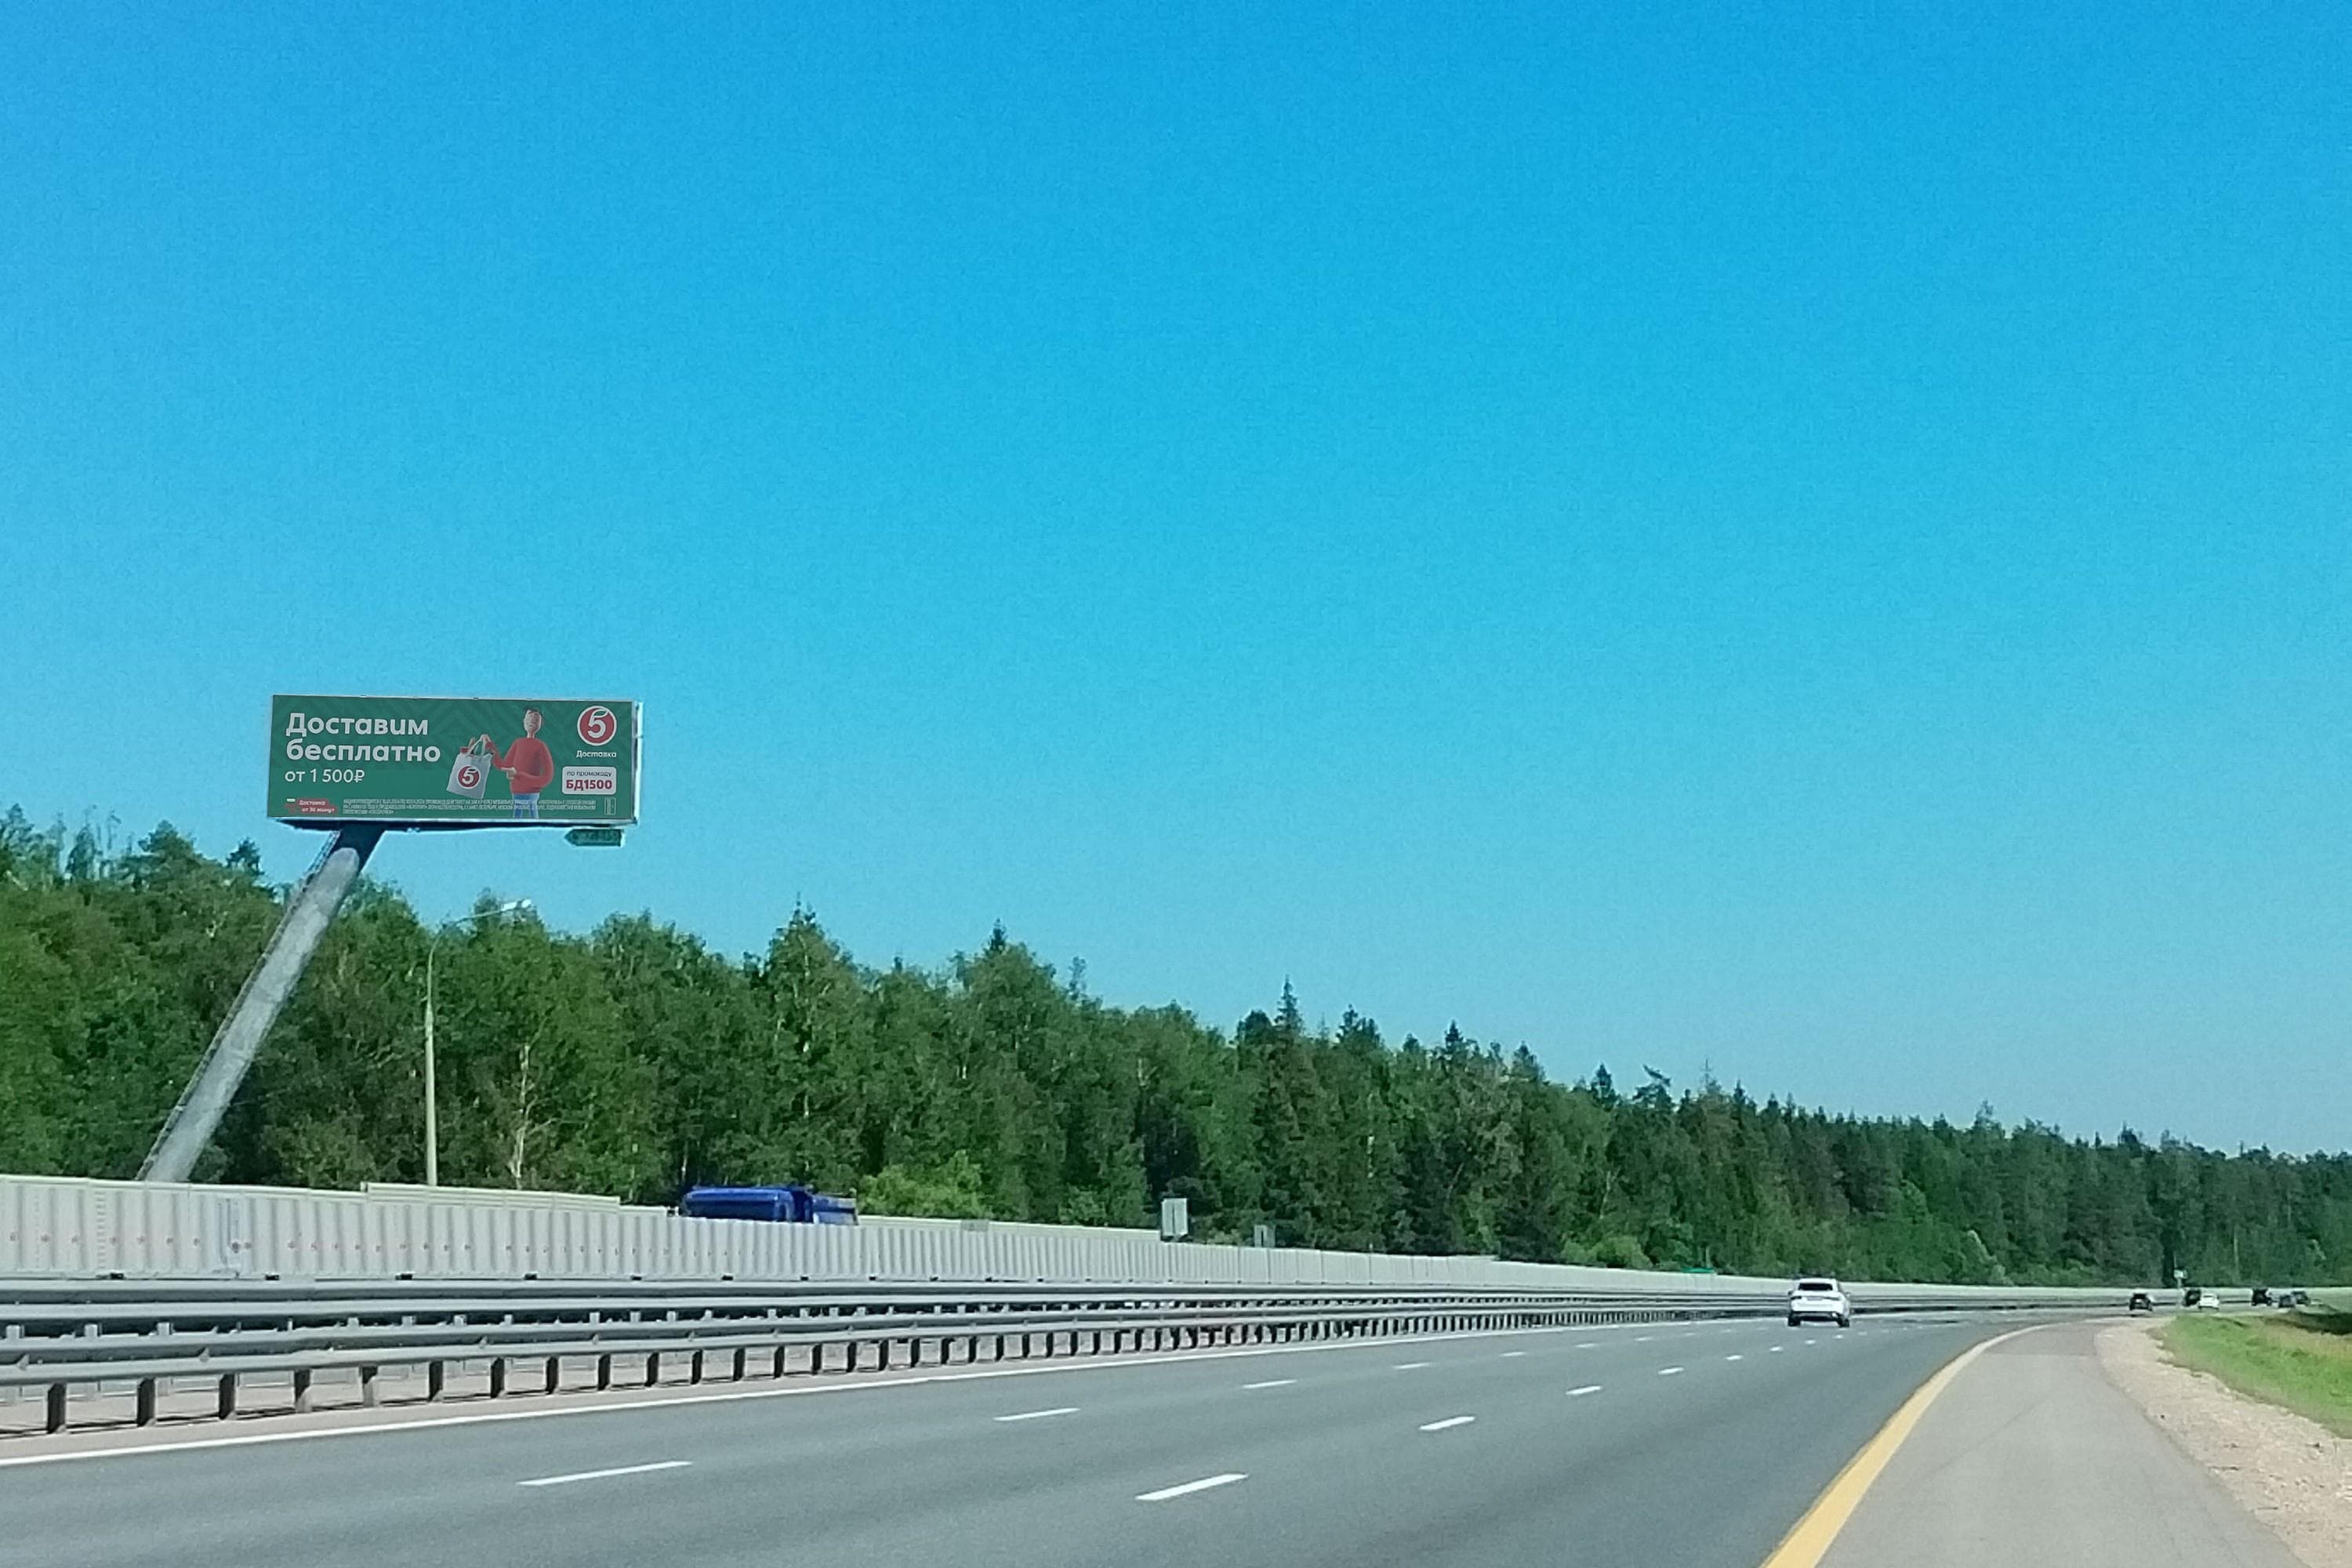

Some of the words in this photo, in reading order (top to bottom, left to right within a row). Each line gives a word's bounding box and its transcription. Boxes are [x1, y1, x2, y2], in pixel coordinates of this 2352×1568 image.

[285, 713, 428, 737] Доставим
[286, 738, 441, 762] бесплатно
[285, 771, 305, 782] от
[566, 779, 612, 790] БД1500
